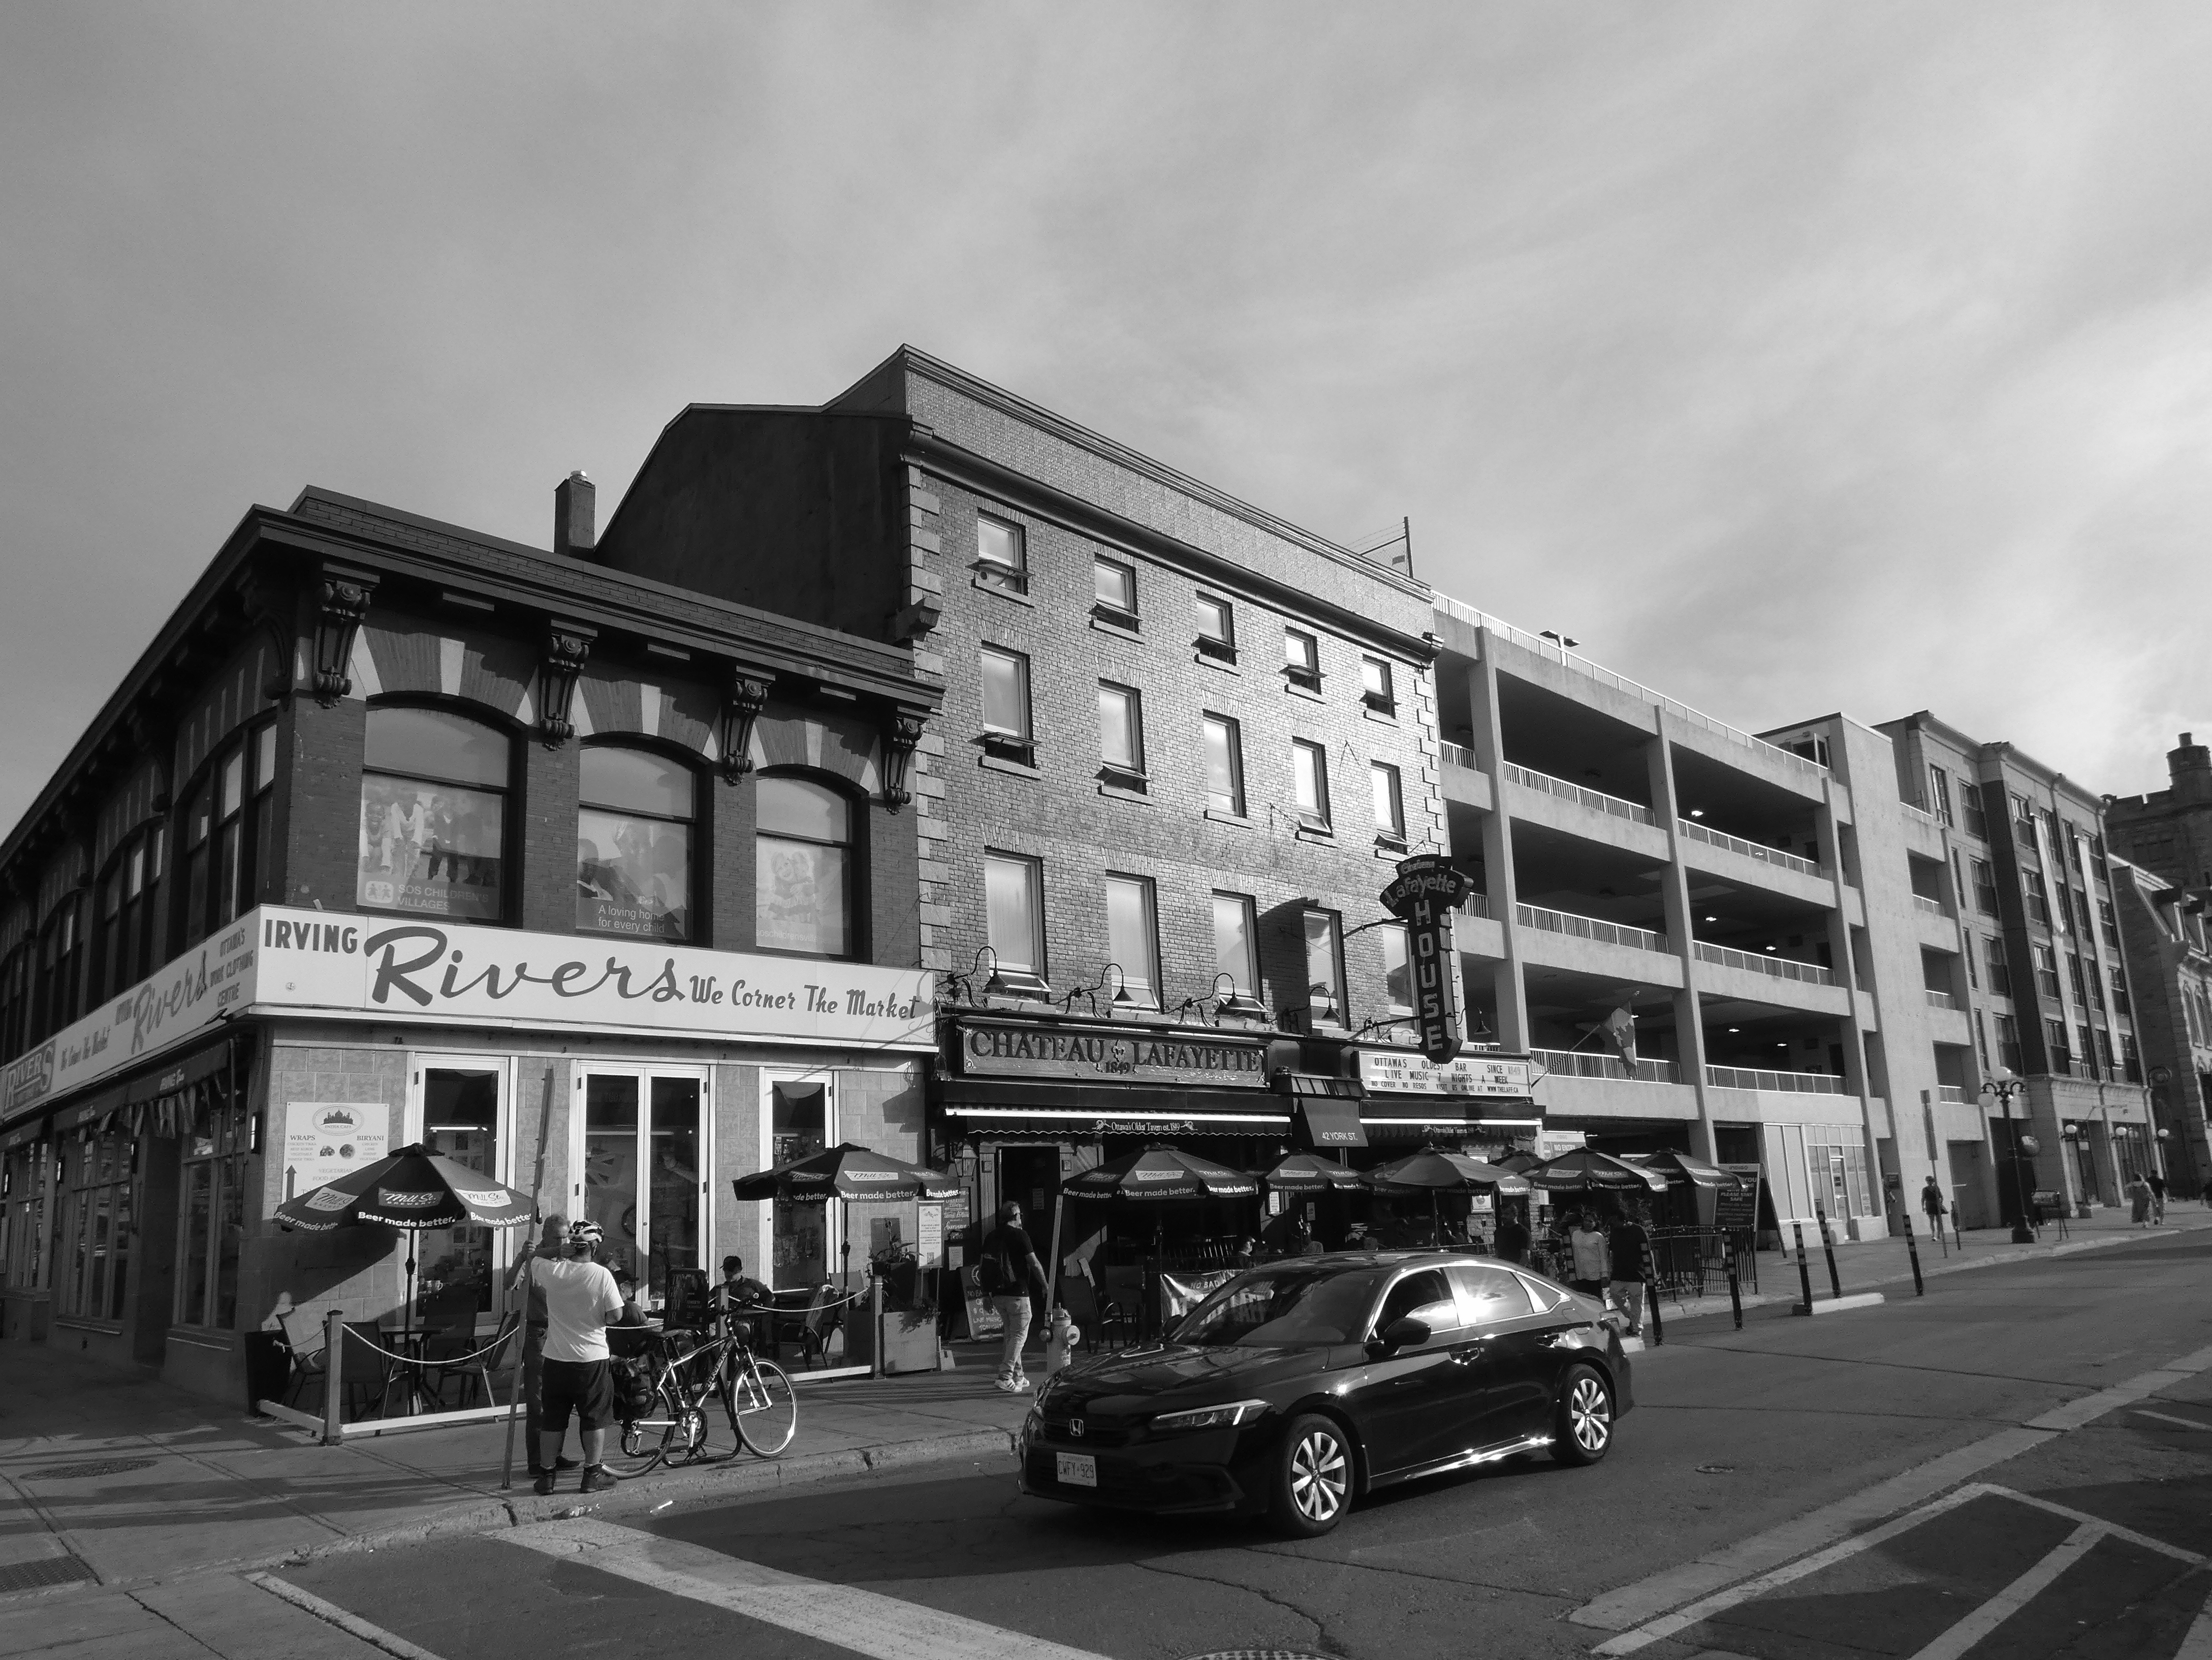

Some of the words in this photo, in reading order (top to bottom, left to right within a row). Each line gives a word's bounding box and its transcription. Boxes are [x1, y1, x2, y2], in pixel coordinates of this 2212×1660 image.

[398, 884, 422, 895] SOS
[424, 887, 489, 903] CHILDREN'S
[1383, 873, 1457, 907] Lafayette
[398, 896, 450, 911] VILLAGES
[598, 904, 606, 915] A
[608, 905, 637, 921] loving
[639, 908, 665, 921] home
[598, 917, 611, 927] for
[614, 921, 641, 933] every
[643, 922, 665, 933] child
[264, 919, 358, 954] IRVING
[363, 926, 686, 1007] Rivers
[1415, 899, 1443, 1051] HOUSE
[689, 975, 723, 1005] We
[732, 979, 796, 1010] Corner
[804, 984, 838, 1014] The
[845, 989, 921, 1019] Market
[1131, 1042, 1259, 1072] LAFAYETTE
[1105, 1060, 1131, 1075] 1849
[1374, 1057, 1407, 1068] OTTAWAS
[1421, 1060, 1443, 1070] OLDEST
[1455, 1062, 1467, 1072] BAR
[1487, 1064, 1503, 1074] SINCE
[1385, 1070, 1402, 1079] LIVE
[1409, 1071, 1429, 1080] MUSIC
[1437, 1072, 1441, 1081] 7
[1450, 1073, 1473, 1083] NIGHTS
[1481, 1075, 1486, 1083] A
[1494, 1075, 1508, 1084] WEEK
[1111, 1121, 1131, 1131] Ottawa's
[1322, 1132, 1330, 1140] 42
[1329, 1132, 1349, 1140] YORK
[1347, 1132, 1358, 1141] ST.
[384, 1193, 416, 1203] Mill
[805, 1193, 828, 1201] better.
[841, 1190, 860, 1199] Beer
[861, 1191, 884, 1199] made
[886, 1190, 916, 1199] better.
[1063, 1187, 1081, 1197] Beer
[1144, 1188, 1167, 1197] made
[1169, 1186, 1195, 1195] better.
[274, 1211, 296, 1223] Beer
[295, 1219, 321, 1231] made
[358, 1211, 384, 1223] Beer
[385, 1217, 417, 1228] made
[419, 1216, 455, 1228] better.
[1204, 1280, 1220, 1289] BAD
[1080, 1463, 1094, 1479] 929
